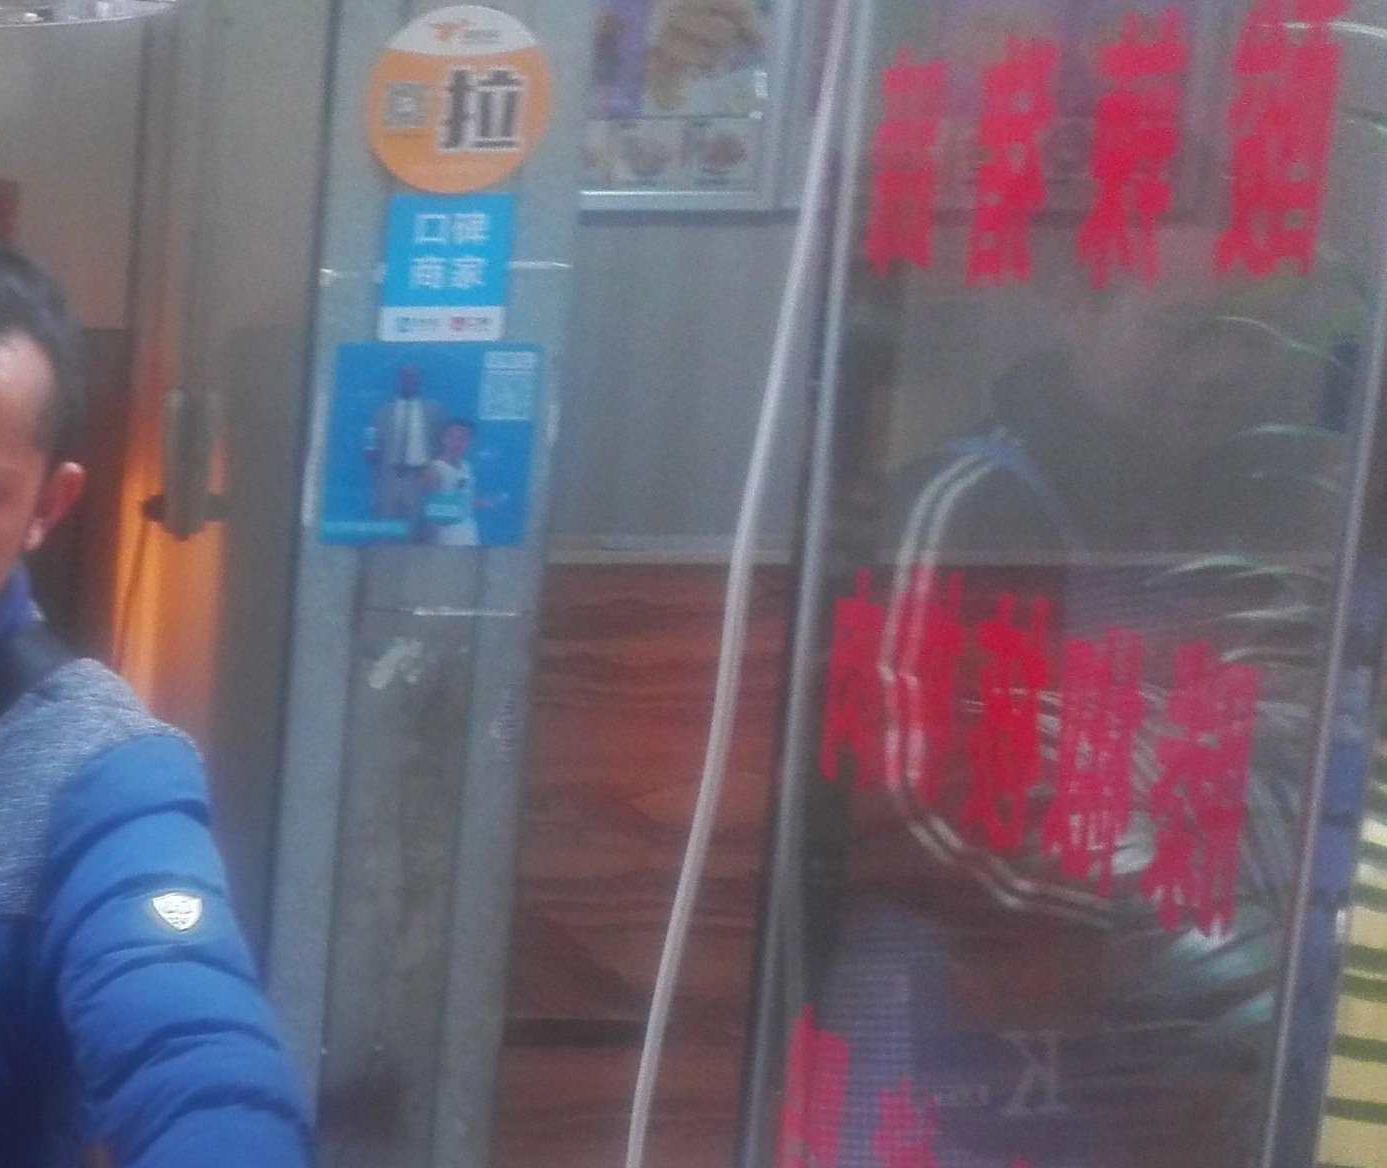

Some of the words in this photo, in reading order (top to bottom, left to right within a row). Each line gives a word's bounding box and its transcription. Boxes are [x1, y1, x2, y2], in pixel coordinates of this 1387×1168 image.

[440, 68, 525, 150] 拉
[412, 212, 489, 244] 口碑
[408, 253, 488, 288] 商家
